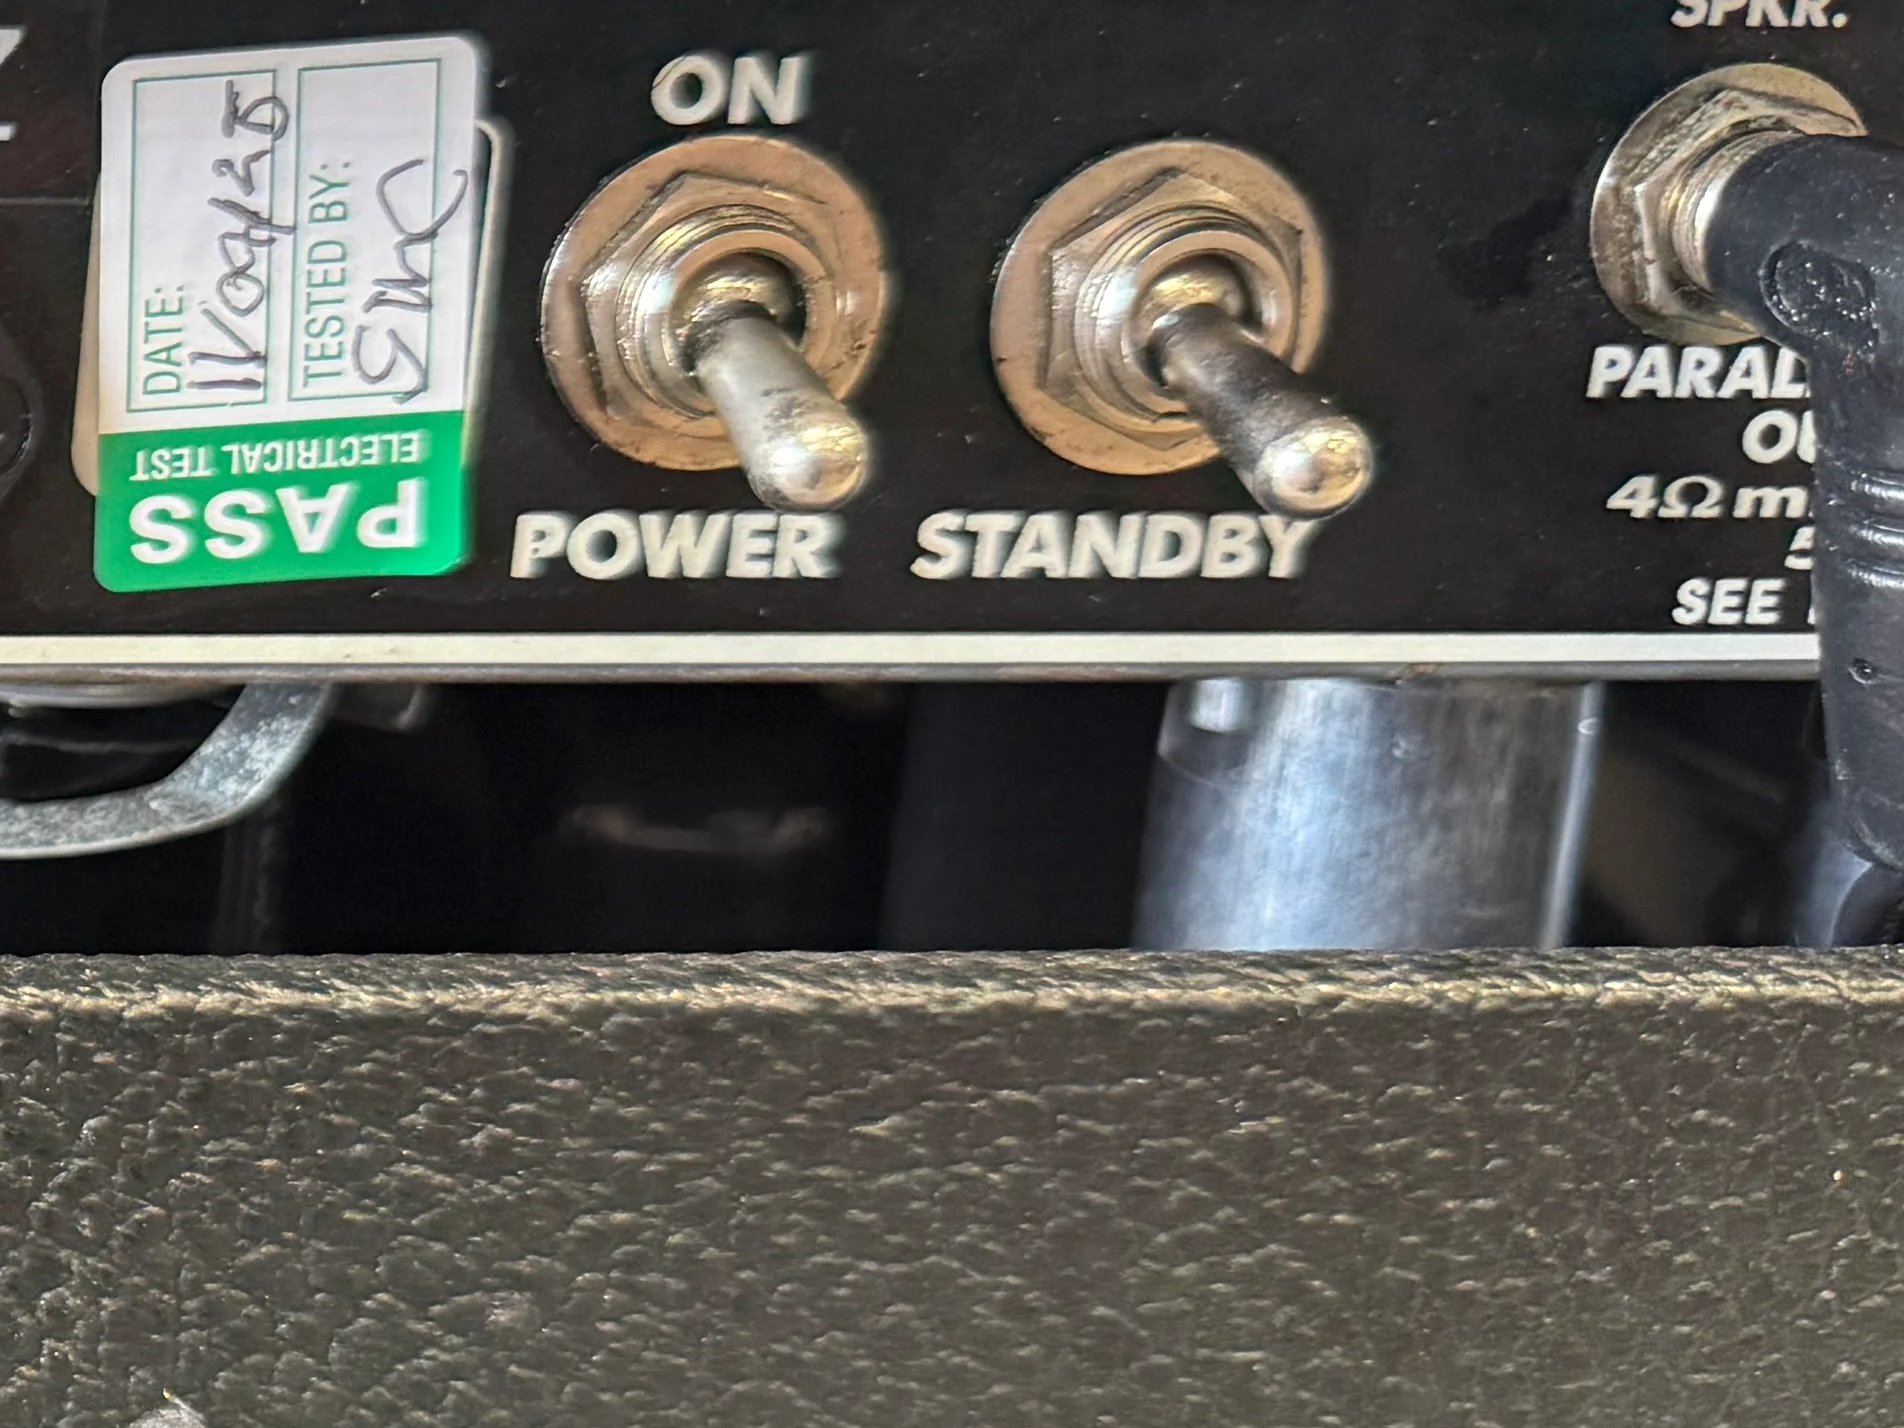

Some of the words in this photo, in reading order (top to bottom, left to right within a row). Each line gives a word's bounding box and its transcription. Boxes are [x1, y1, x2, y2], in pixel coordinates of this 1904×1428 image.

[650, 51, 815, 127] ON
[308, 160, 352, 225] BY:
[142, 283, 187, 396] DATE:
[302, 238, 345, 388] TESTED
[1585, 343, 1811, 399] PARAL
[133, 445, 210, 481] TEST
[222, 429, 425, 475] ELECTRICAL
[129, 476, 428, 565] PASS
[509, 510, 847, 579] POWER
[909, 510, 1324, 579] STANDBY
[1671, 576, 1787, 626] SEE
